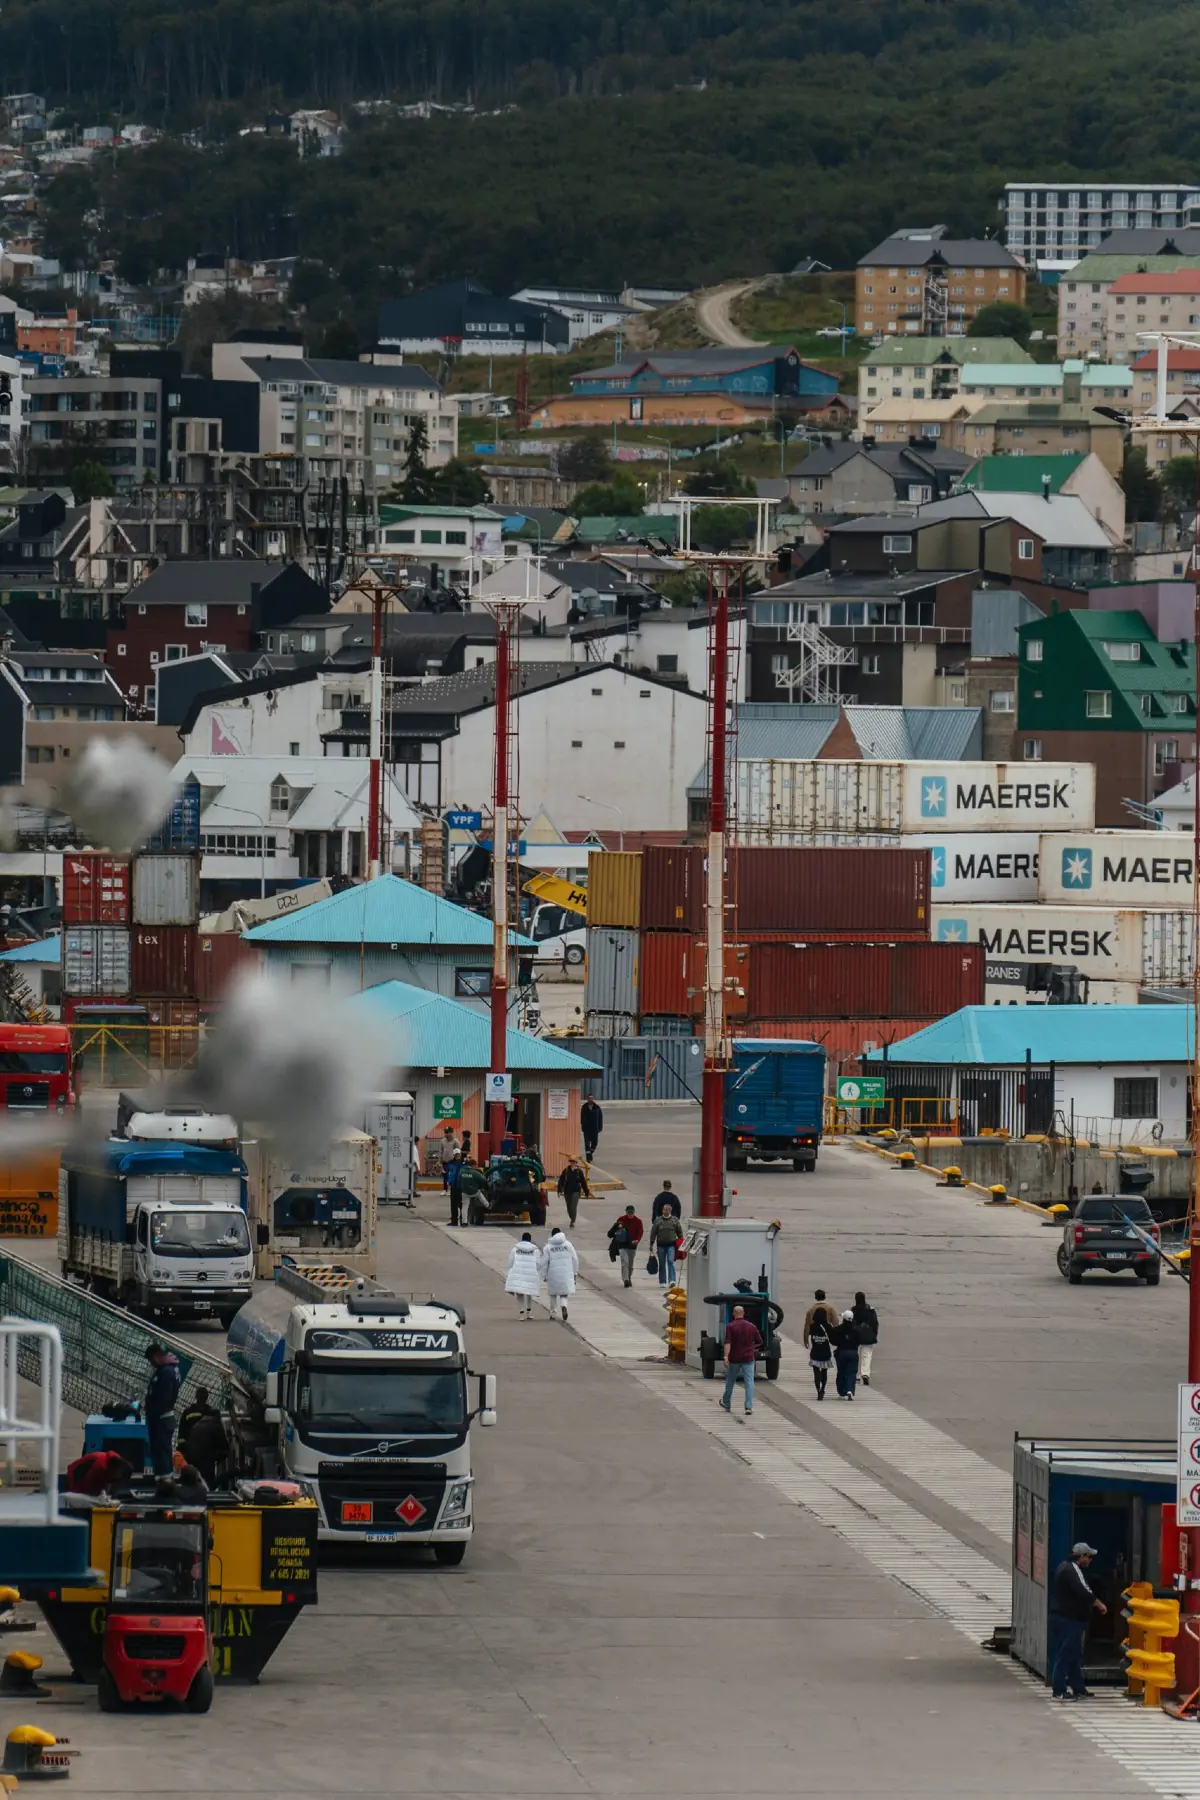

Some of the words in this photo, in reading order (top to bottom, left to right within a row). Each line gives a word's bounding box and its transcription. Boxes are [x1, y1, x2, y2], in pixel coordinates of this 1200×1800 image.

[956, 784, 1069, 809] MAERSK
[452, 815, 474, 824] YPF
[138, 933, 158, 945] tex
[979, 928, 1112, 956] MAERSK
[411, 1334, 449, 1348] FM
